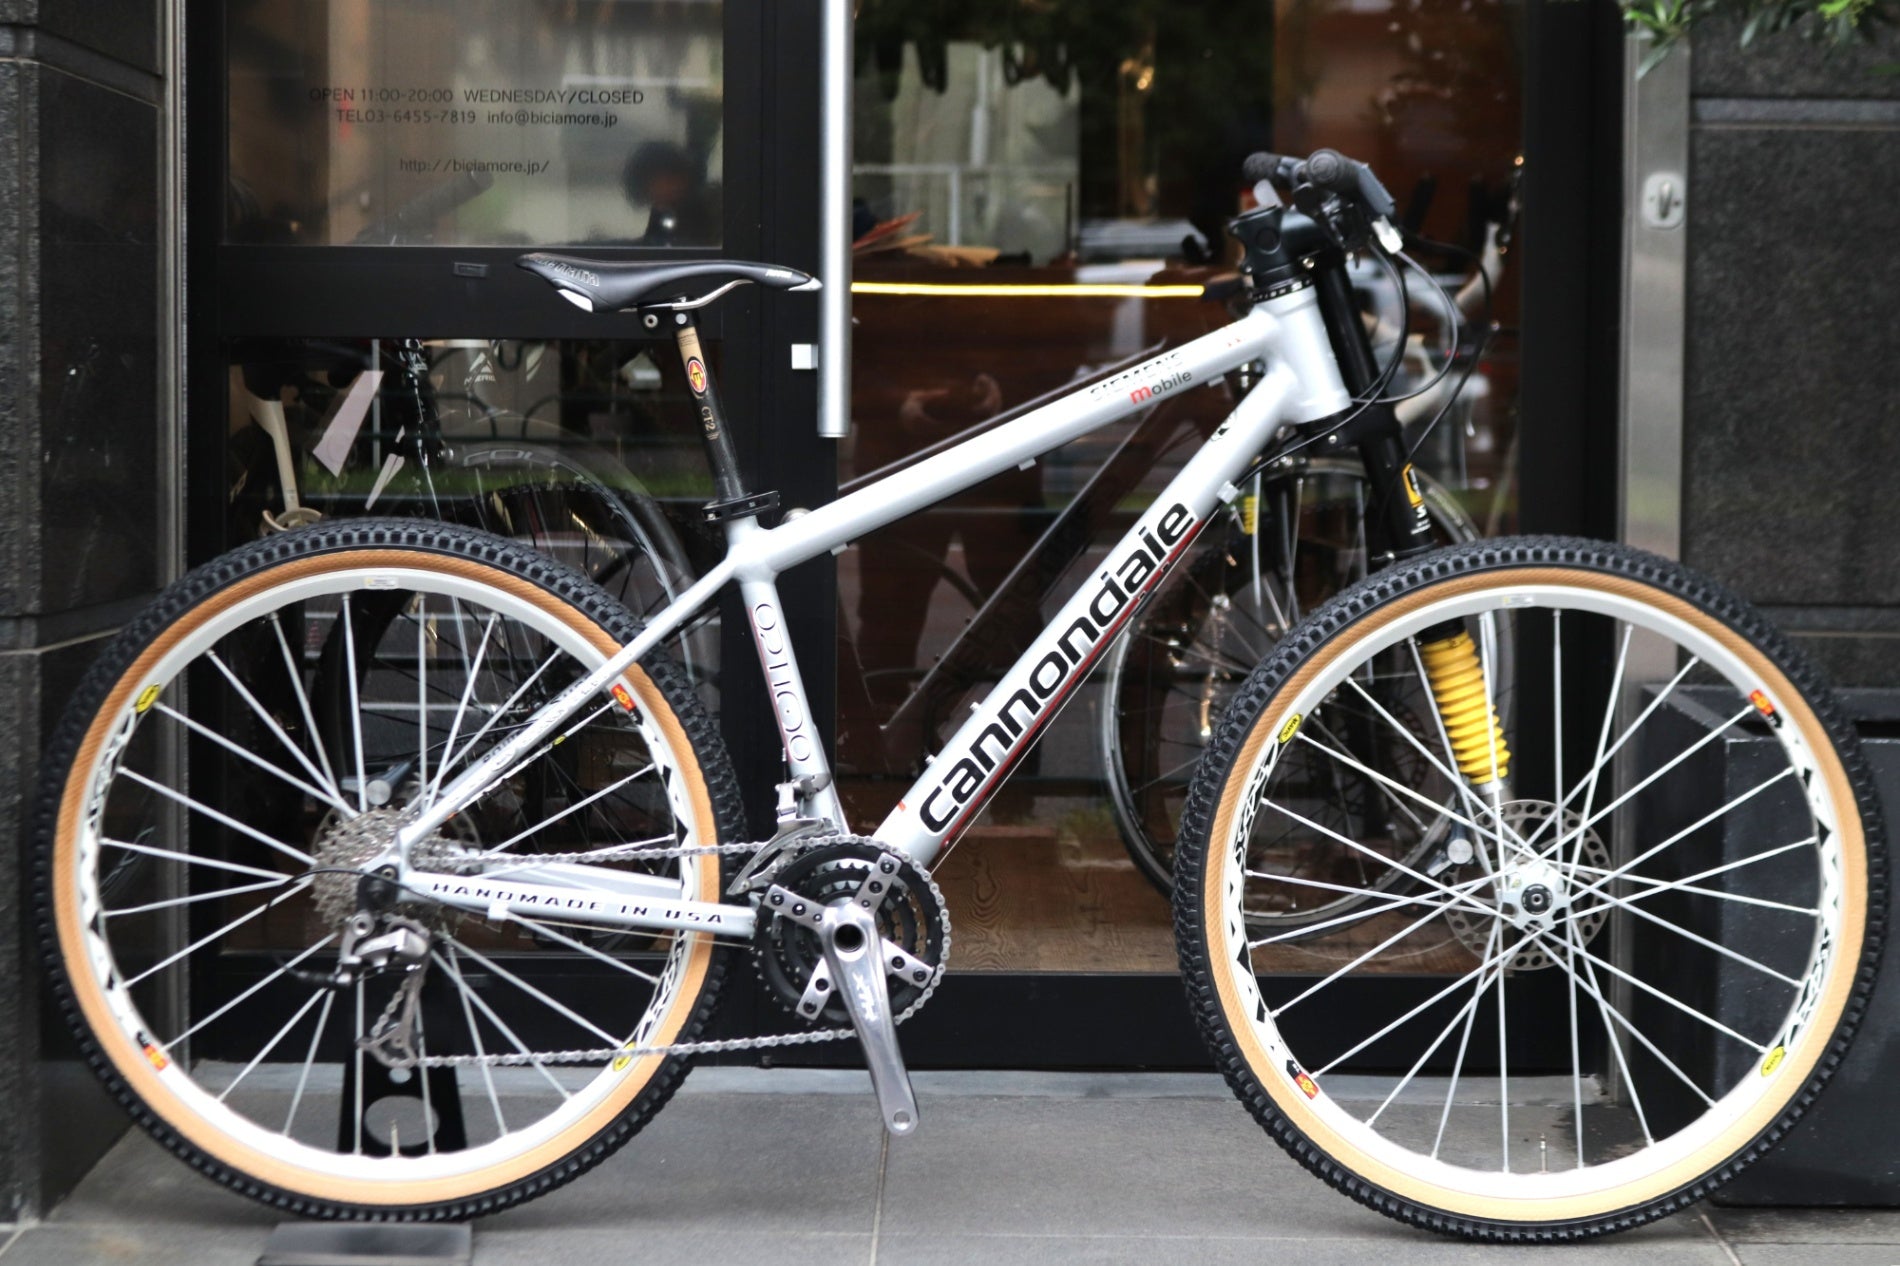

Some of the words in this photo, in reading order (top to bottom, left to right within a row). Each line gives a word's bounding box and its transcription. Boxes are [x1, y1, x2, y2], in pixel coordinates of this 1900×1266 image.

[309, 88, 354, 101] OPEN
[361, 88, 454, 102] 11:00-20:00
[464, 89, 644, 104] WEDNESDAY/CLOSED
[487, 111, 618, 128] info@biciamore.jp
[400, 159, 550, 174] http://biciamore.jp/
[1130, 371, 1192, 405] mobile
[919, 503, 1195, 834] cannondale
[433, 882, 602, 911] HANDMADE
[620, 905, 647, 917] IN
[665, 909, 724, 924] USA
